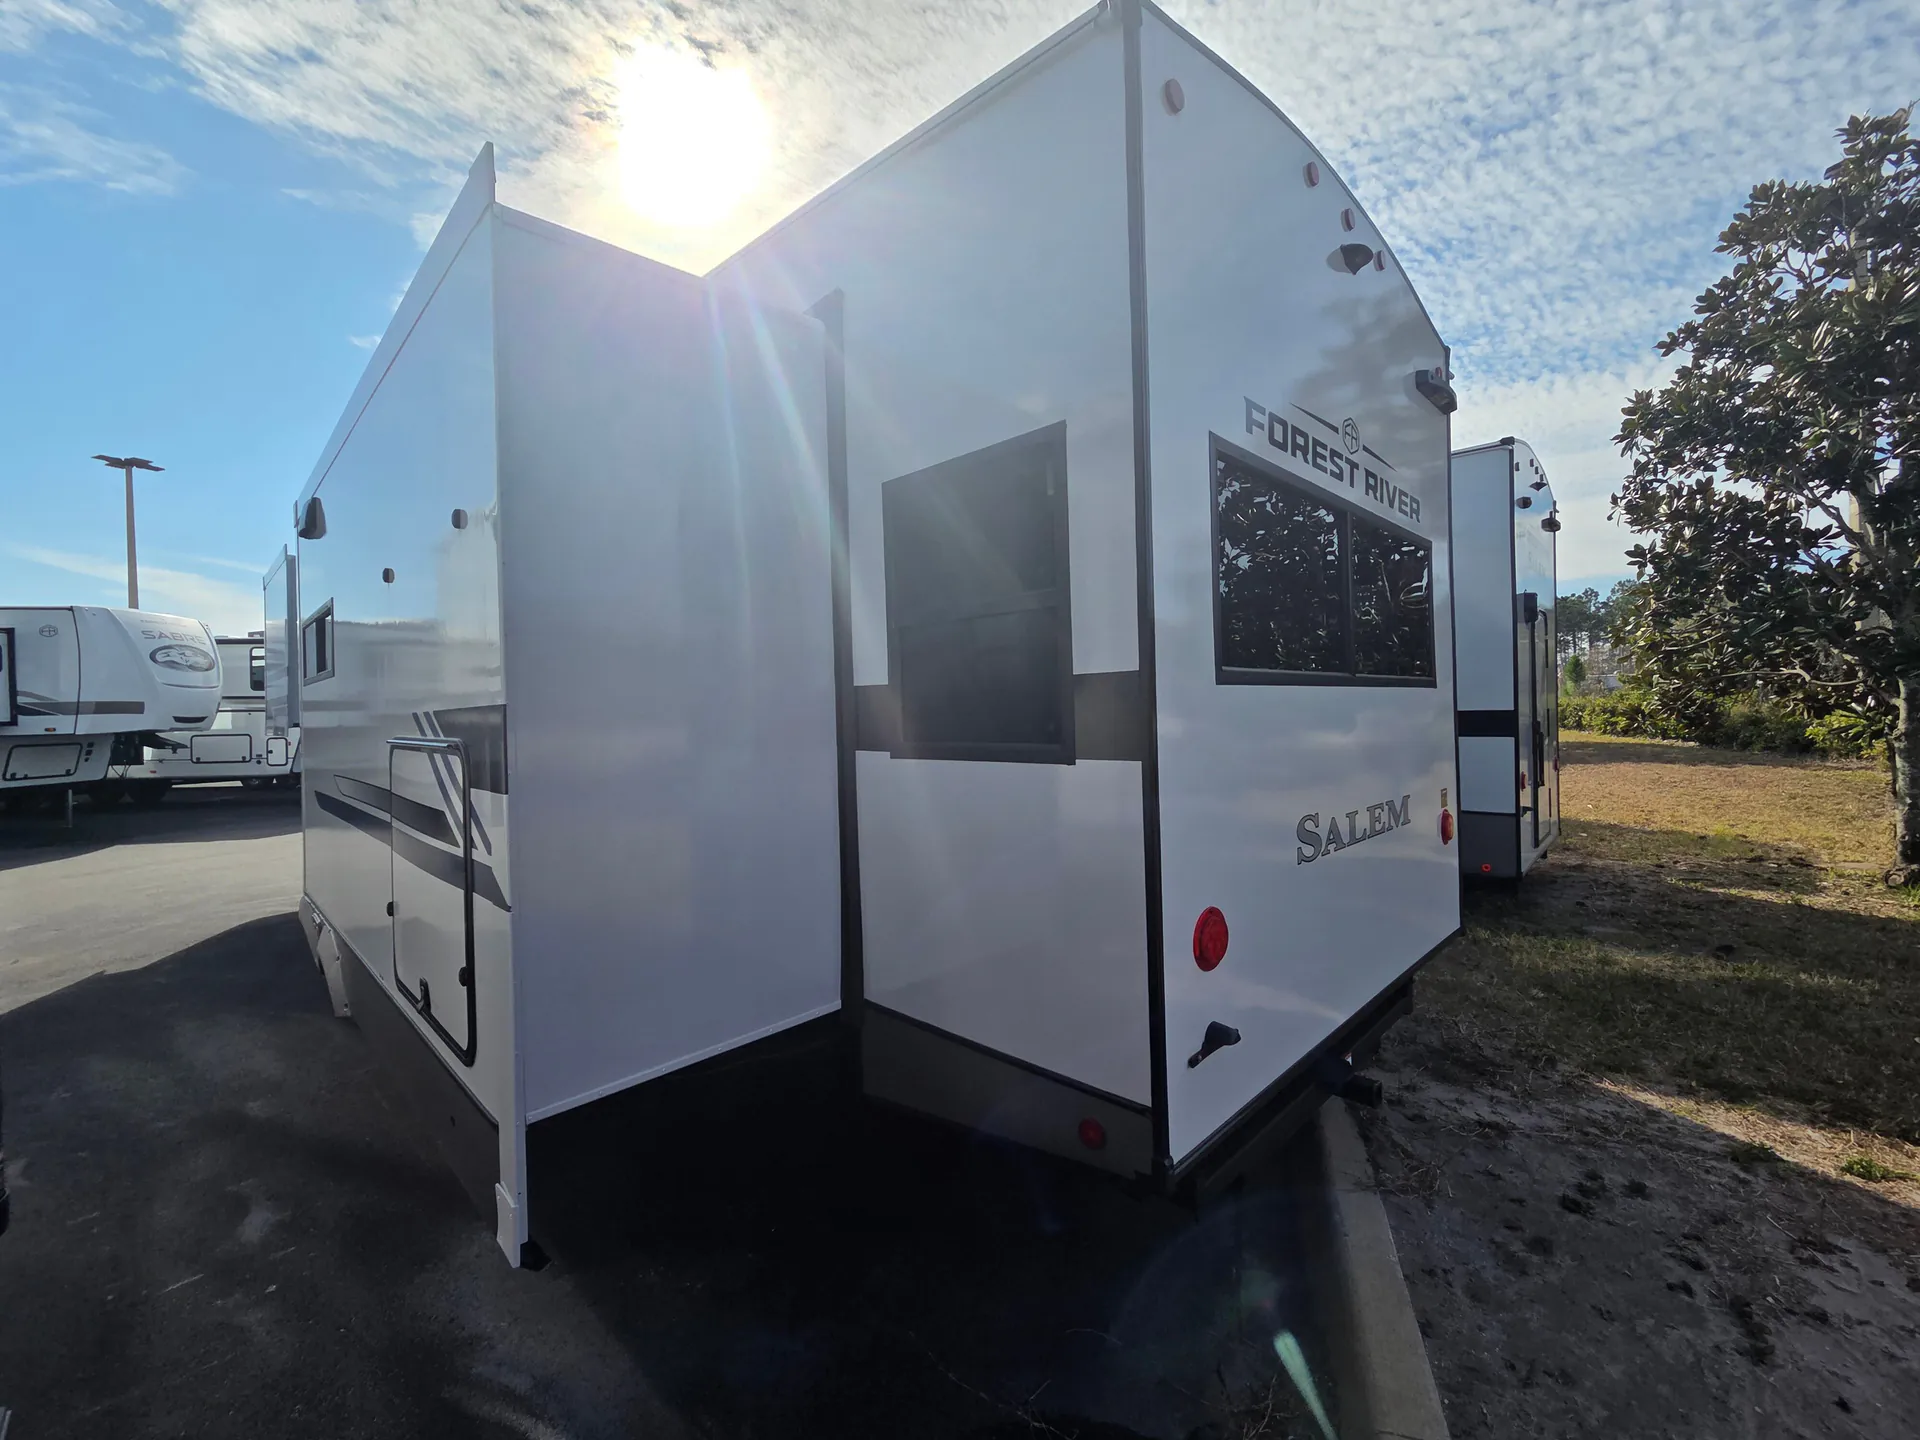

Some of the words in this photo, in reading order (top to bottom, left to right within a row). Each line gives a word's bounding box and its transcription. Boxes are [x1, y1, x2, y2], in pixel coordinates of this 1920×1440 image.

[1244, 396, 1359, 488] FOREST
[1364, 467, 1420, 523] RIVER
[141, 630, 207, 645] SABRE
[1297, 795, 1411, 865] SALEM
